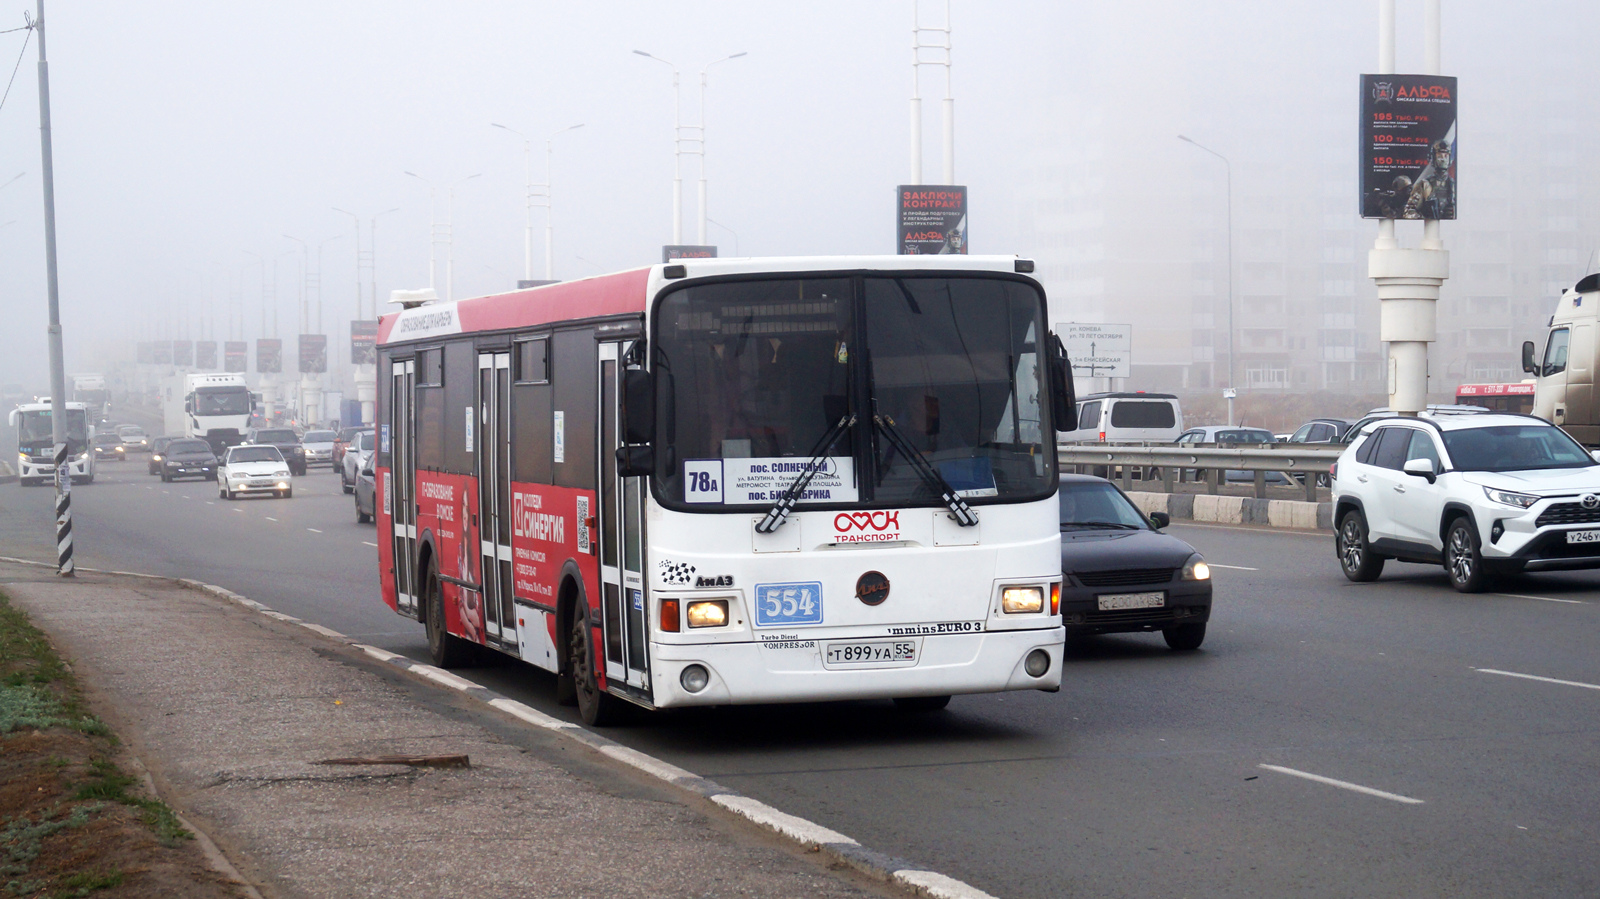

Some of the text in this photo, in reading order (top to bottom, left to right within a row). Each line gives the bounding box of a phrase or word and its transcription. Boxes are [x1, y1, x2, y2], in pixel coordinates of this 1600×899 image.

[1396, 85, 1450, 98] АЛЬФА
[903, 192, 962, 200] ЗАКЛЮЧИ
[905, 232, 944, 240] АЛЬФА
[750, 462, 828, 473] пос. СОЛНЕЧНЫЙ
[749, 489, 831, 501] пос. БИБРИКА
[524, 511, 564, 544] СИНЕРГИЯ
[834, 532, 900, 542] ТРАНСПОРТ
[766, 588, 815, 617] 554
[834, 644, 910, 661] Т899УА 55
